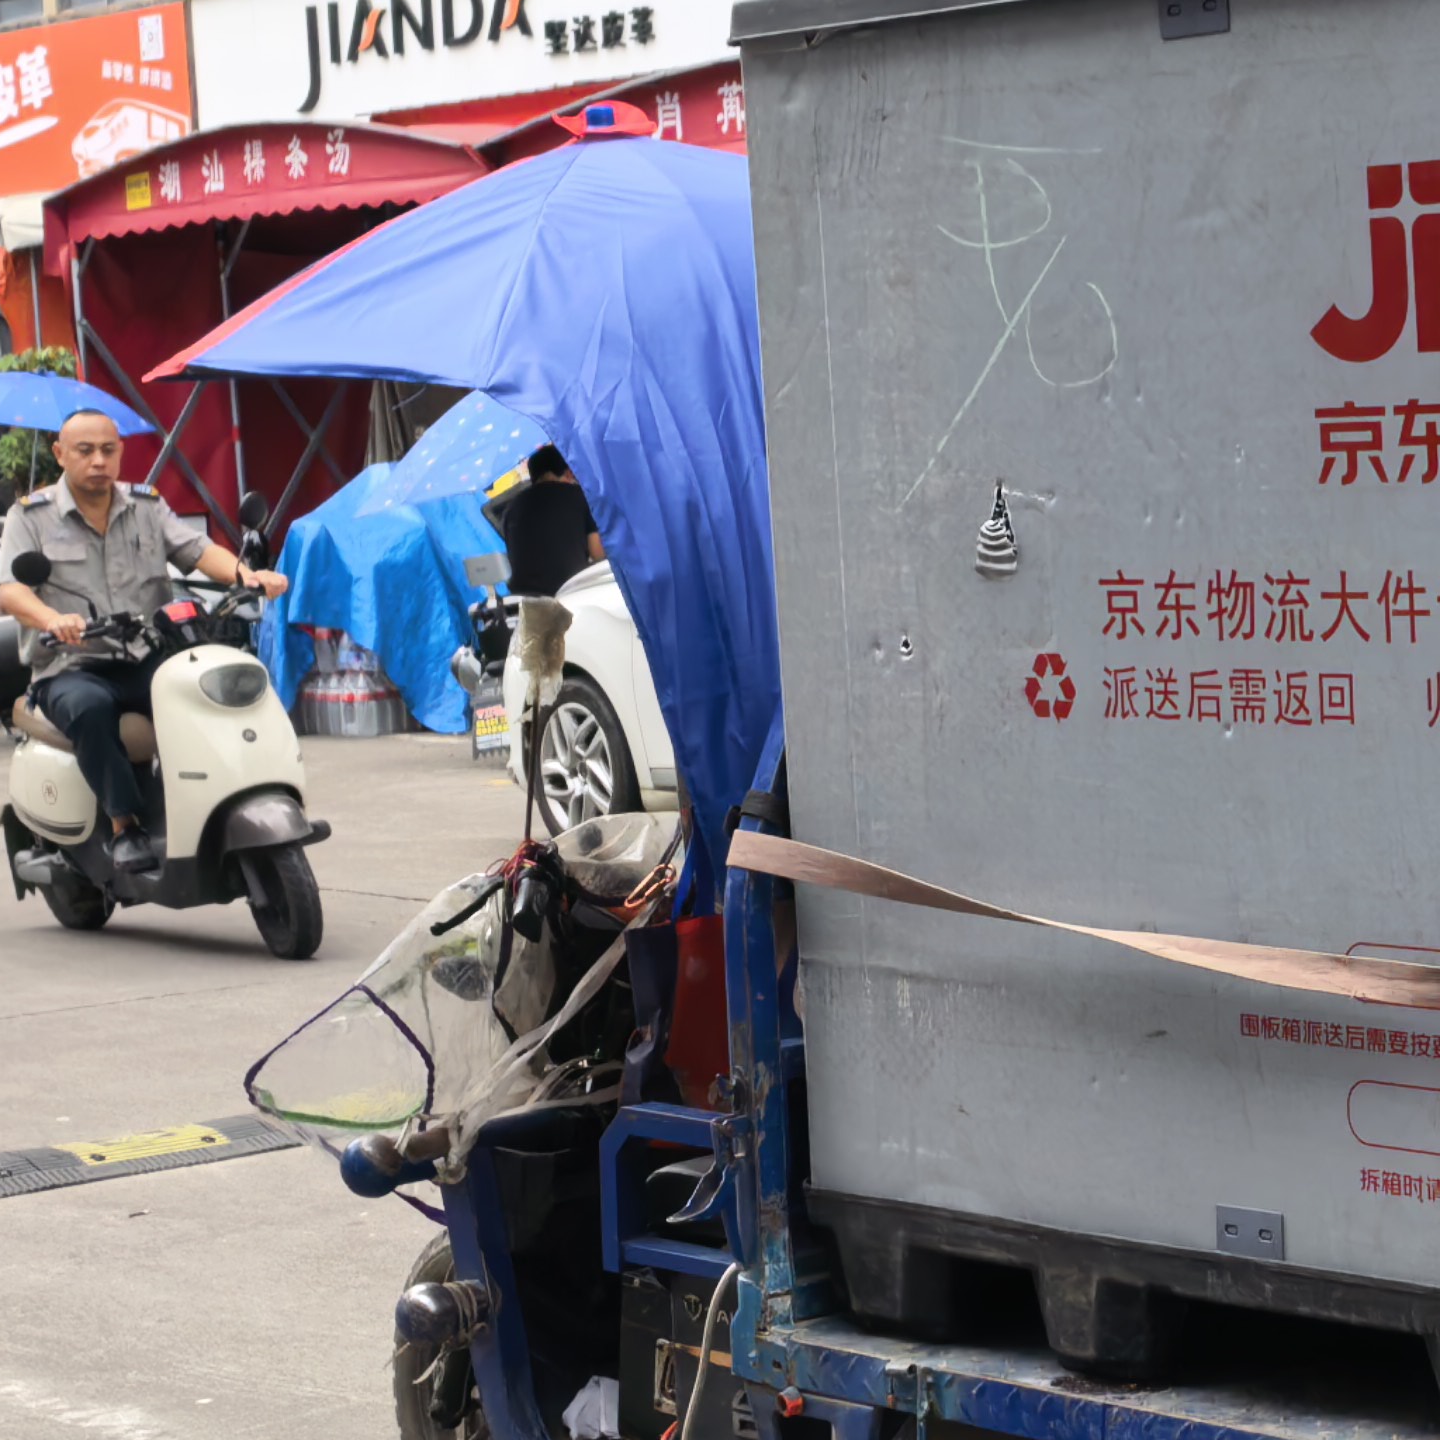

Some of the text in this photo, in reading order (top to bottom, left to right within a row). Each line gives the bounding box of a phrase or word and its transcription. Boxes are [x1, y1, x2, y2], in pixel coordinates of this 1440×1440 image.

[1102, 667, 1357, 728] 派送后需返回
